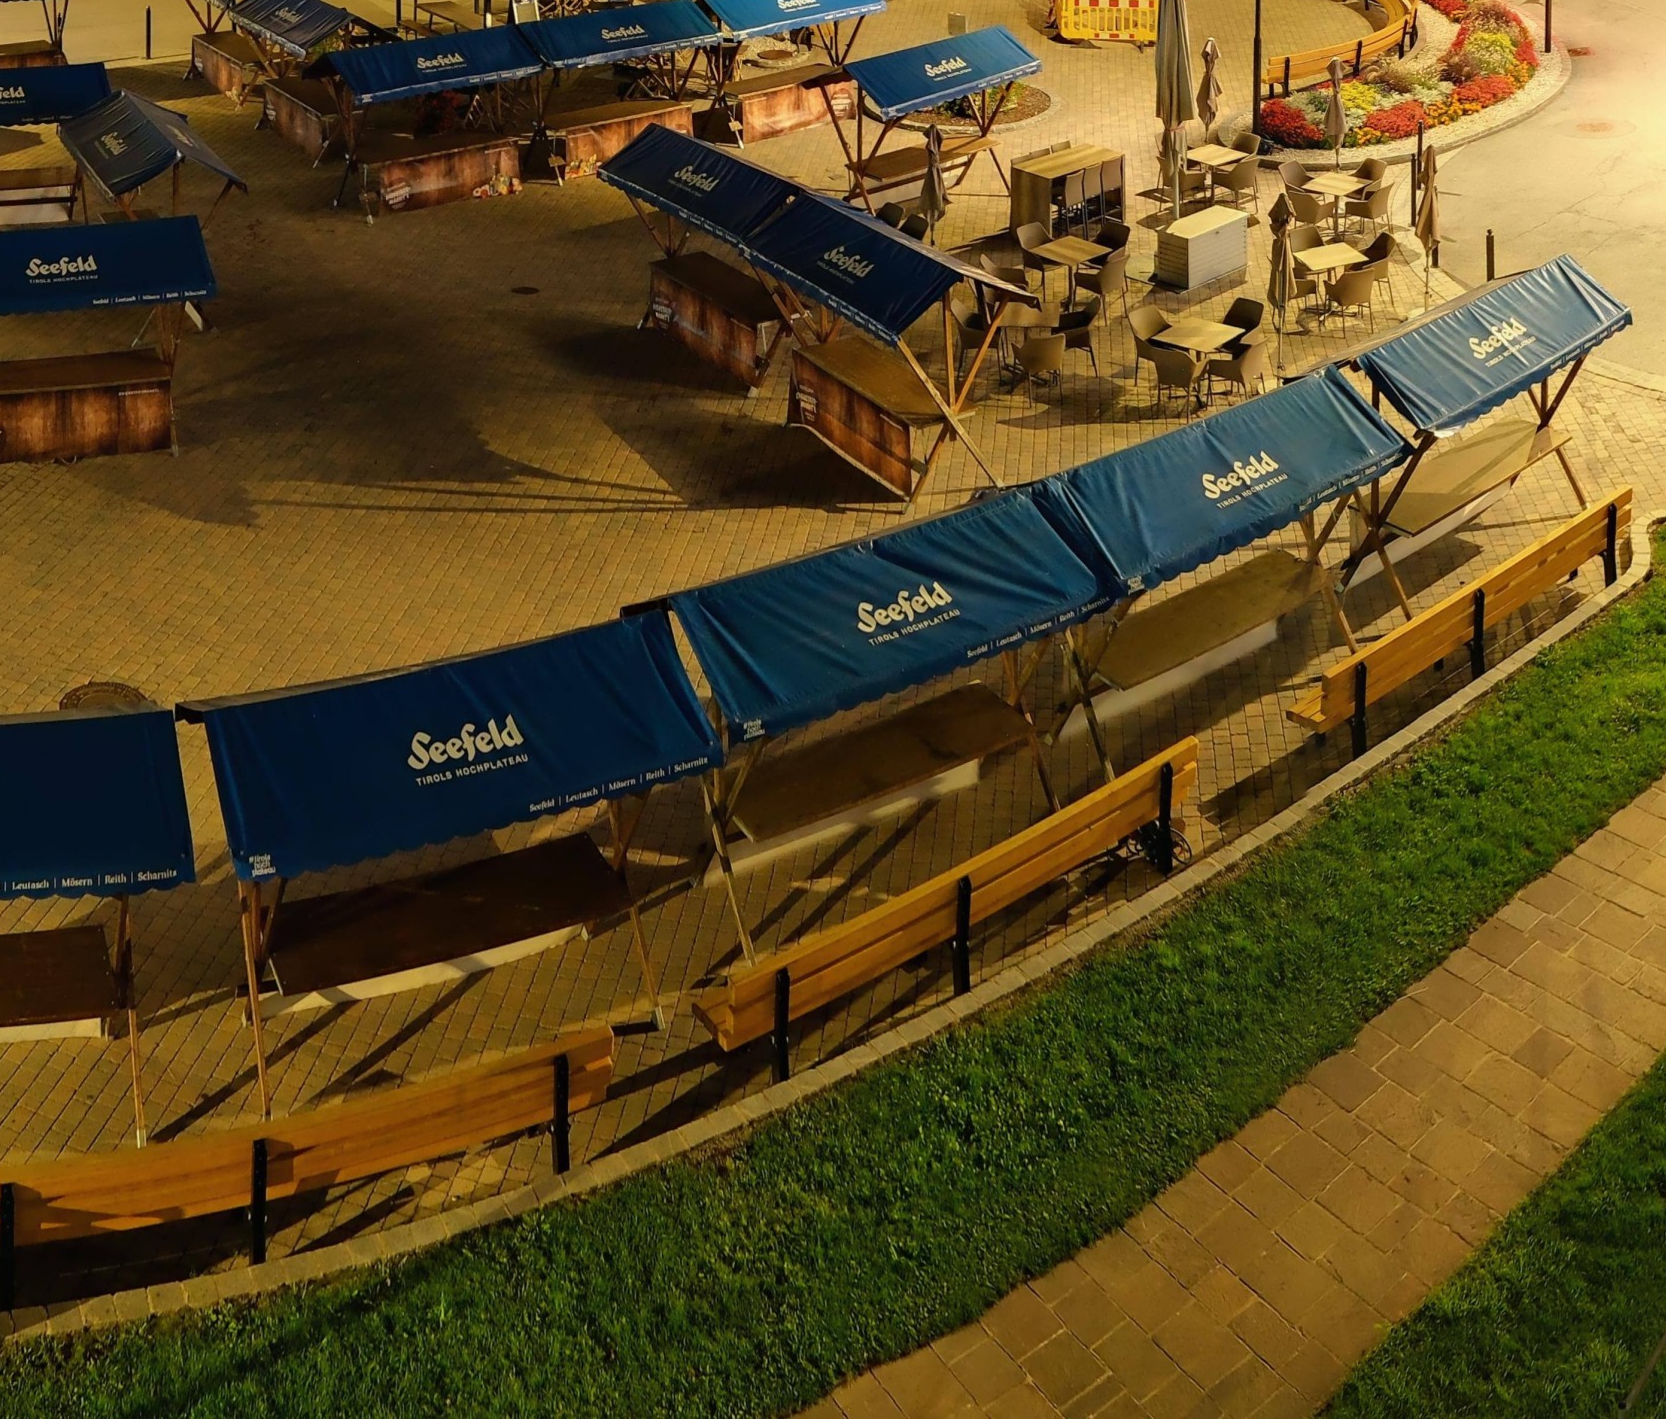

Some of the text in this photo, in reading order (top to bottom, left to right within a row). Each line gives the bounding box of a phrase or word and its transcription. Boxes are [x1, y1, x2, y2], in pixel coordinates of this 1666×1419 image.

[601, 24, 644, 40] Seefeld
[417, 53, 464, 69] Seefeld
[925, 56, 967, 77] Seefeld
[674, 165, 719, 192] Seefeld
[26, 254, 97, 277] Seefeld
[823, 246, 875, 278] Seefeld
[1468, 316, 1526, 360] Seefeld
[1201, 450, 1280, 501] Seefeld
[1216, 472, 1288, 510] TIROLS HOCHPLATEAU
[856, 581, 954, 635] Seefeld
[868, 607, 961, 647] TIROLS HOCHPLATEAU
[407, 714, 524, 772] Seefeld
[415, 753, 529, 787] TIROLS HOCHPLATEAU
[529, 756, 708, 812] Seefeld Leutasch Mösern Reith Scharnitz
[12, 879, 49, 891] Leutasch
[62, 877, 93, 888] Mösern
[105, 872, 126, 884] Reith
[137, 869, 177, 882] Scharnitz
